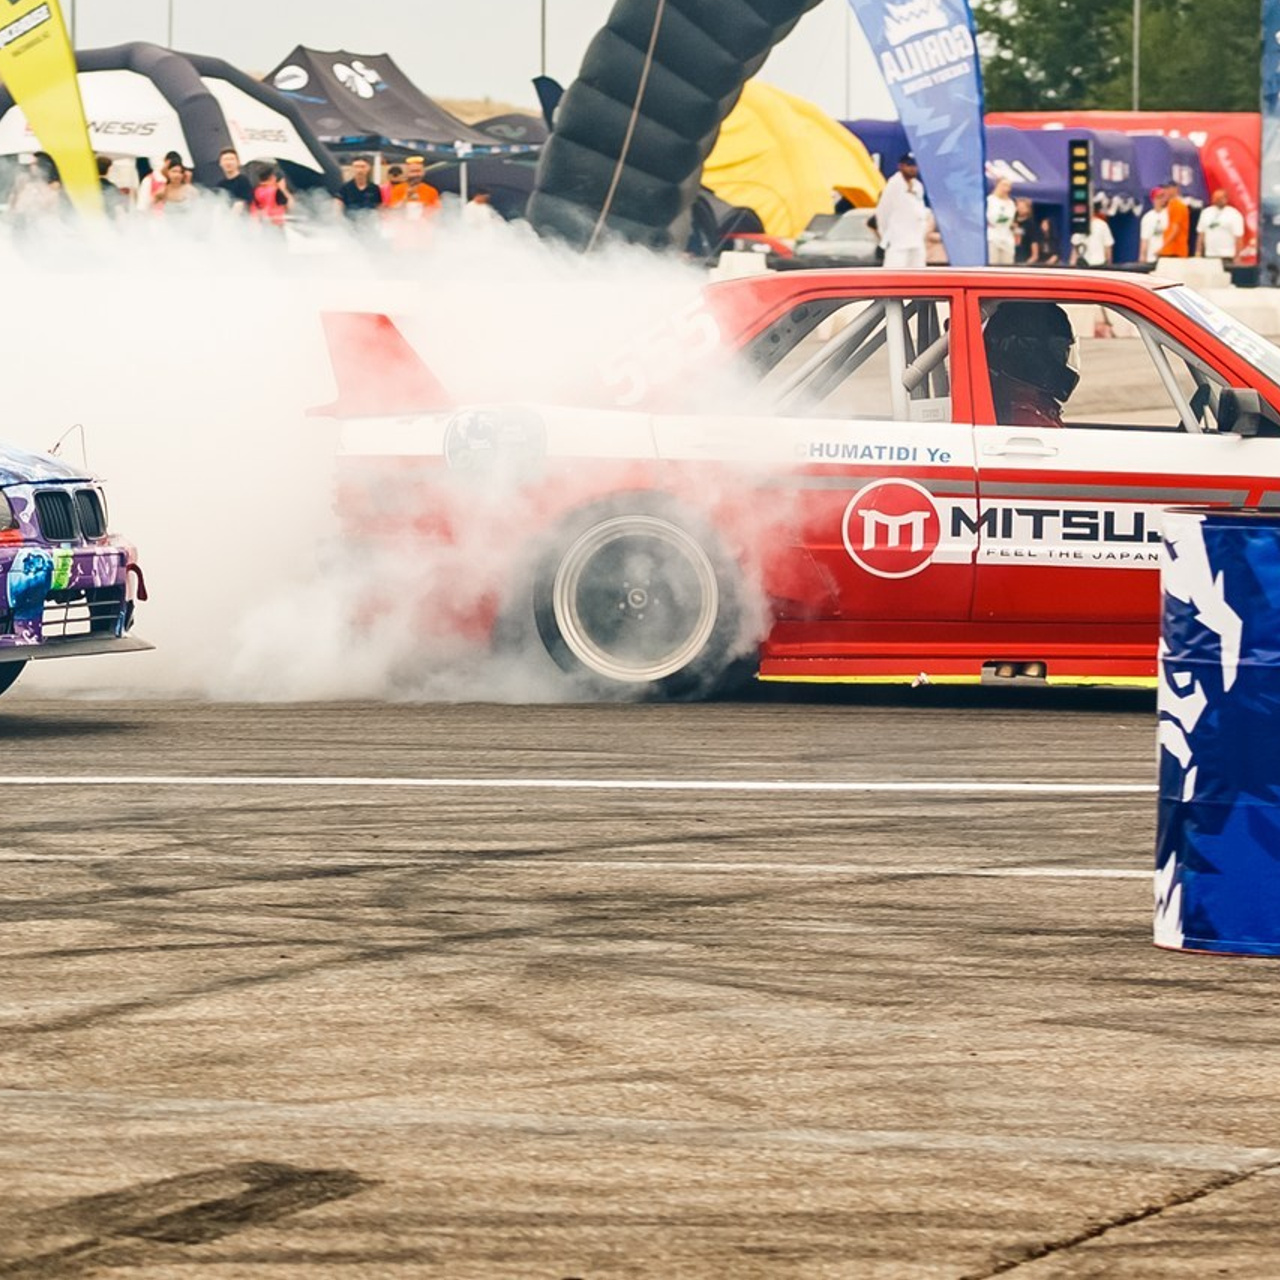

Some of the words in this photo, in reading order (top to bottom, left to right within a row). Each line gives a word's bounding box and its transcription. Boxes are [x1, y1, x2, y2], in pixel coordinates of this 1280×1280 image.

[927, 448, 952, 463] Ye
[986, 548, 1037, 558] FEEL
[1048, 550, 1084, 559] THE
